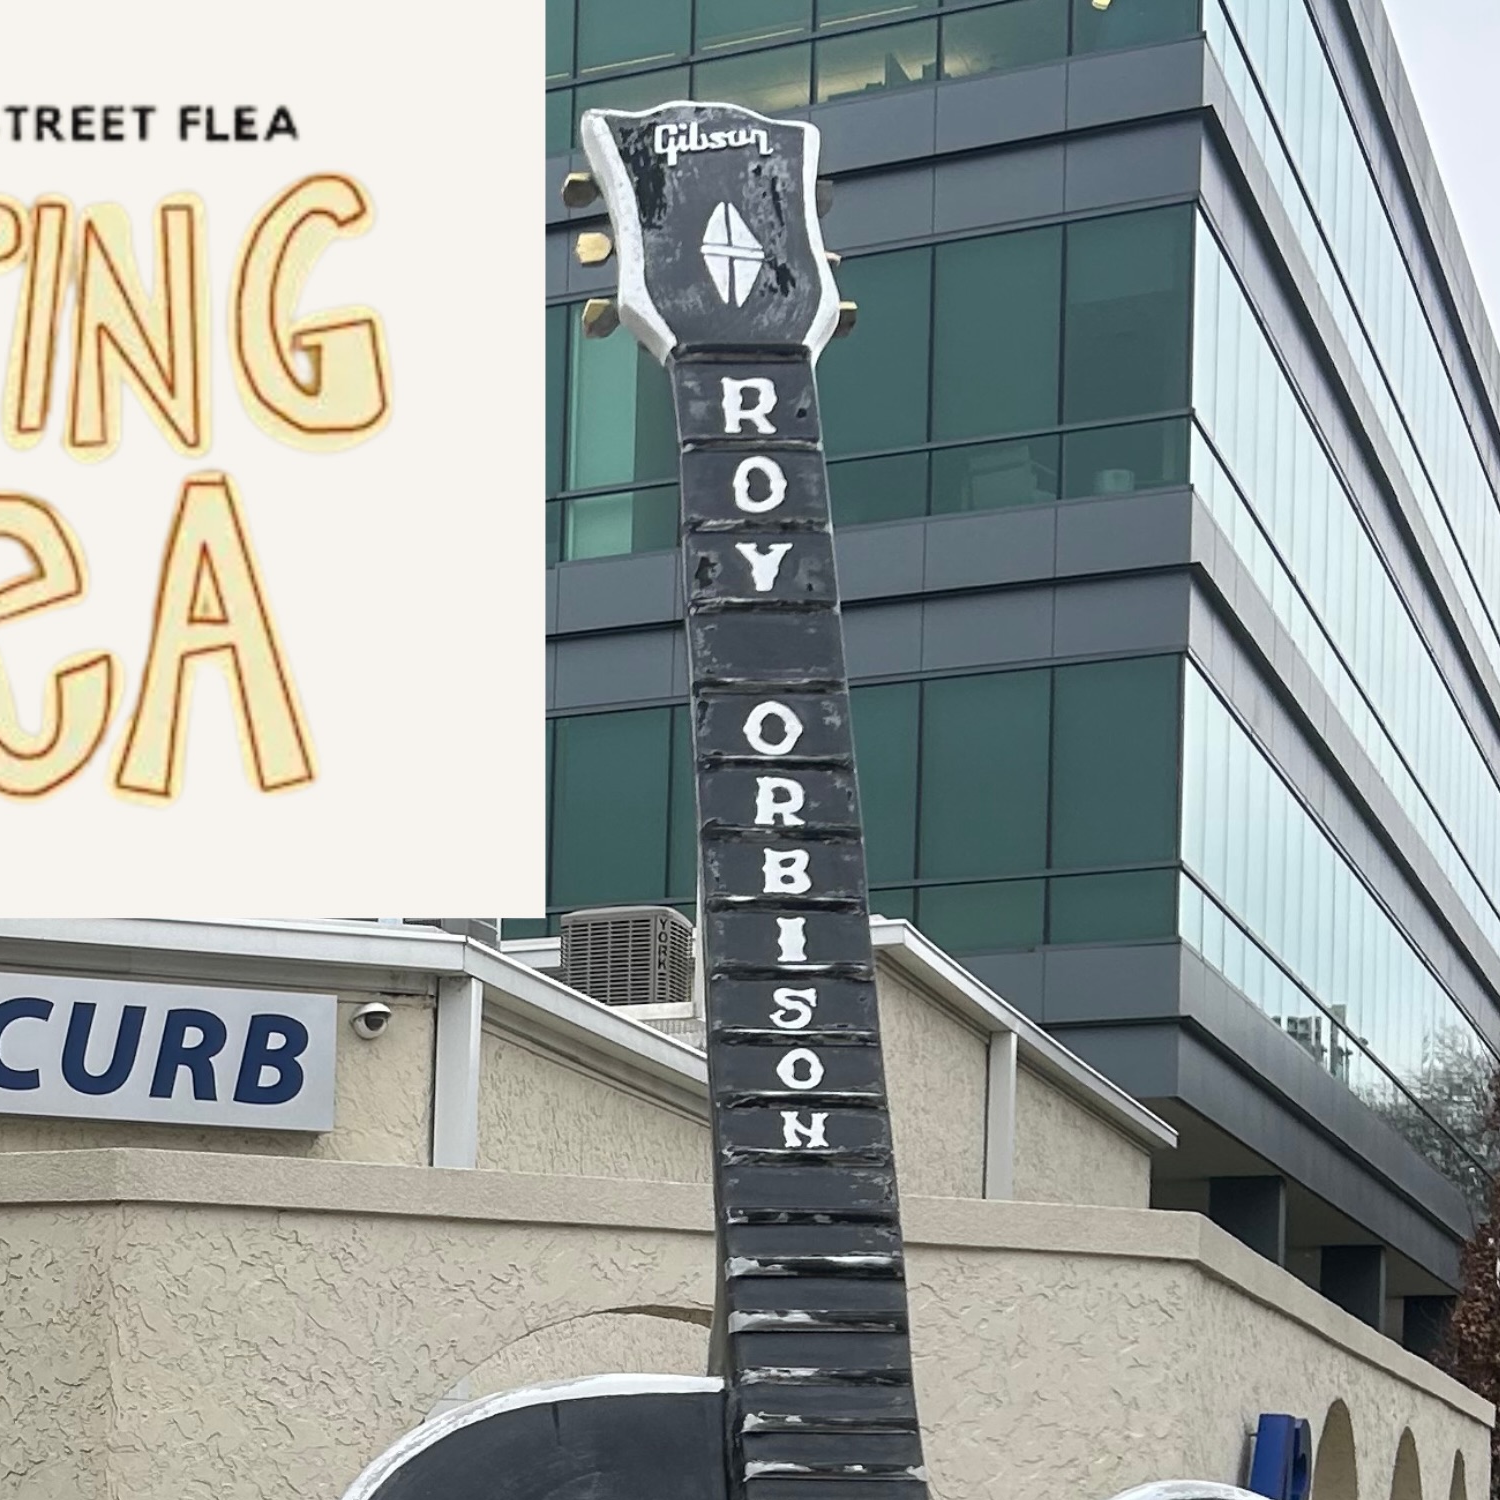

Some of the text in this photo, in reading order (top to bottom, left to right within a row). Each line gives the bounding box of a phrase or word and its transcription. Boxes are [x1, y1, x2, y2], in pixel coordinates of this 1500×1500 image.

[654, 121, 775, 167] Gibson
[720, 376, 830, 1149] ROY ORBISON
[657, 918, 668, 970] YORK
